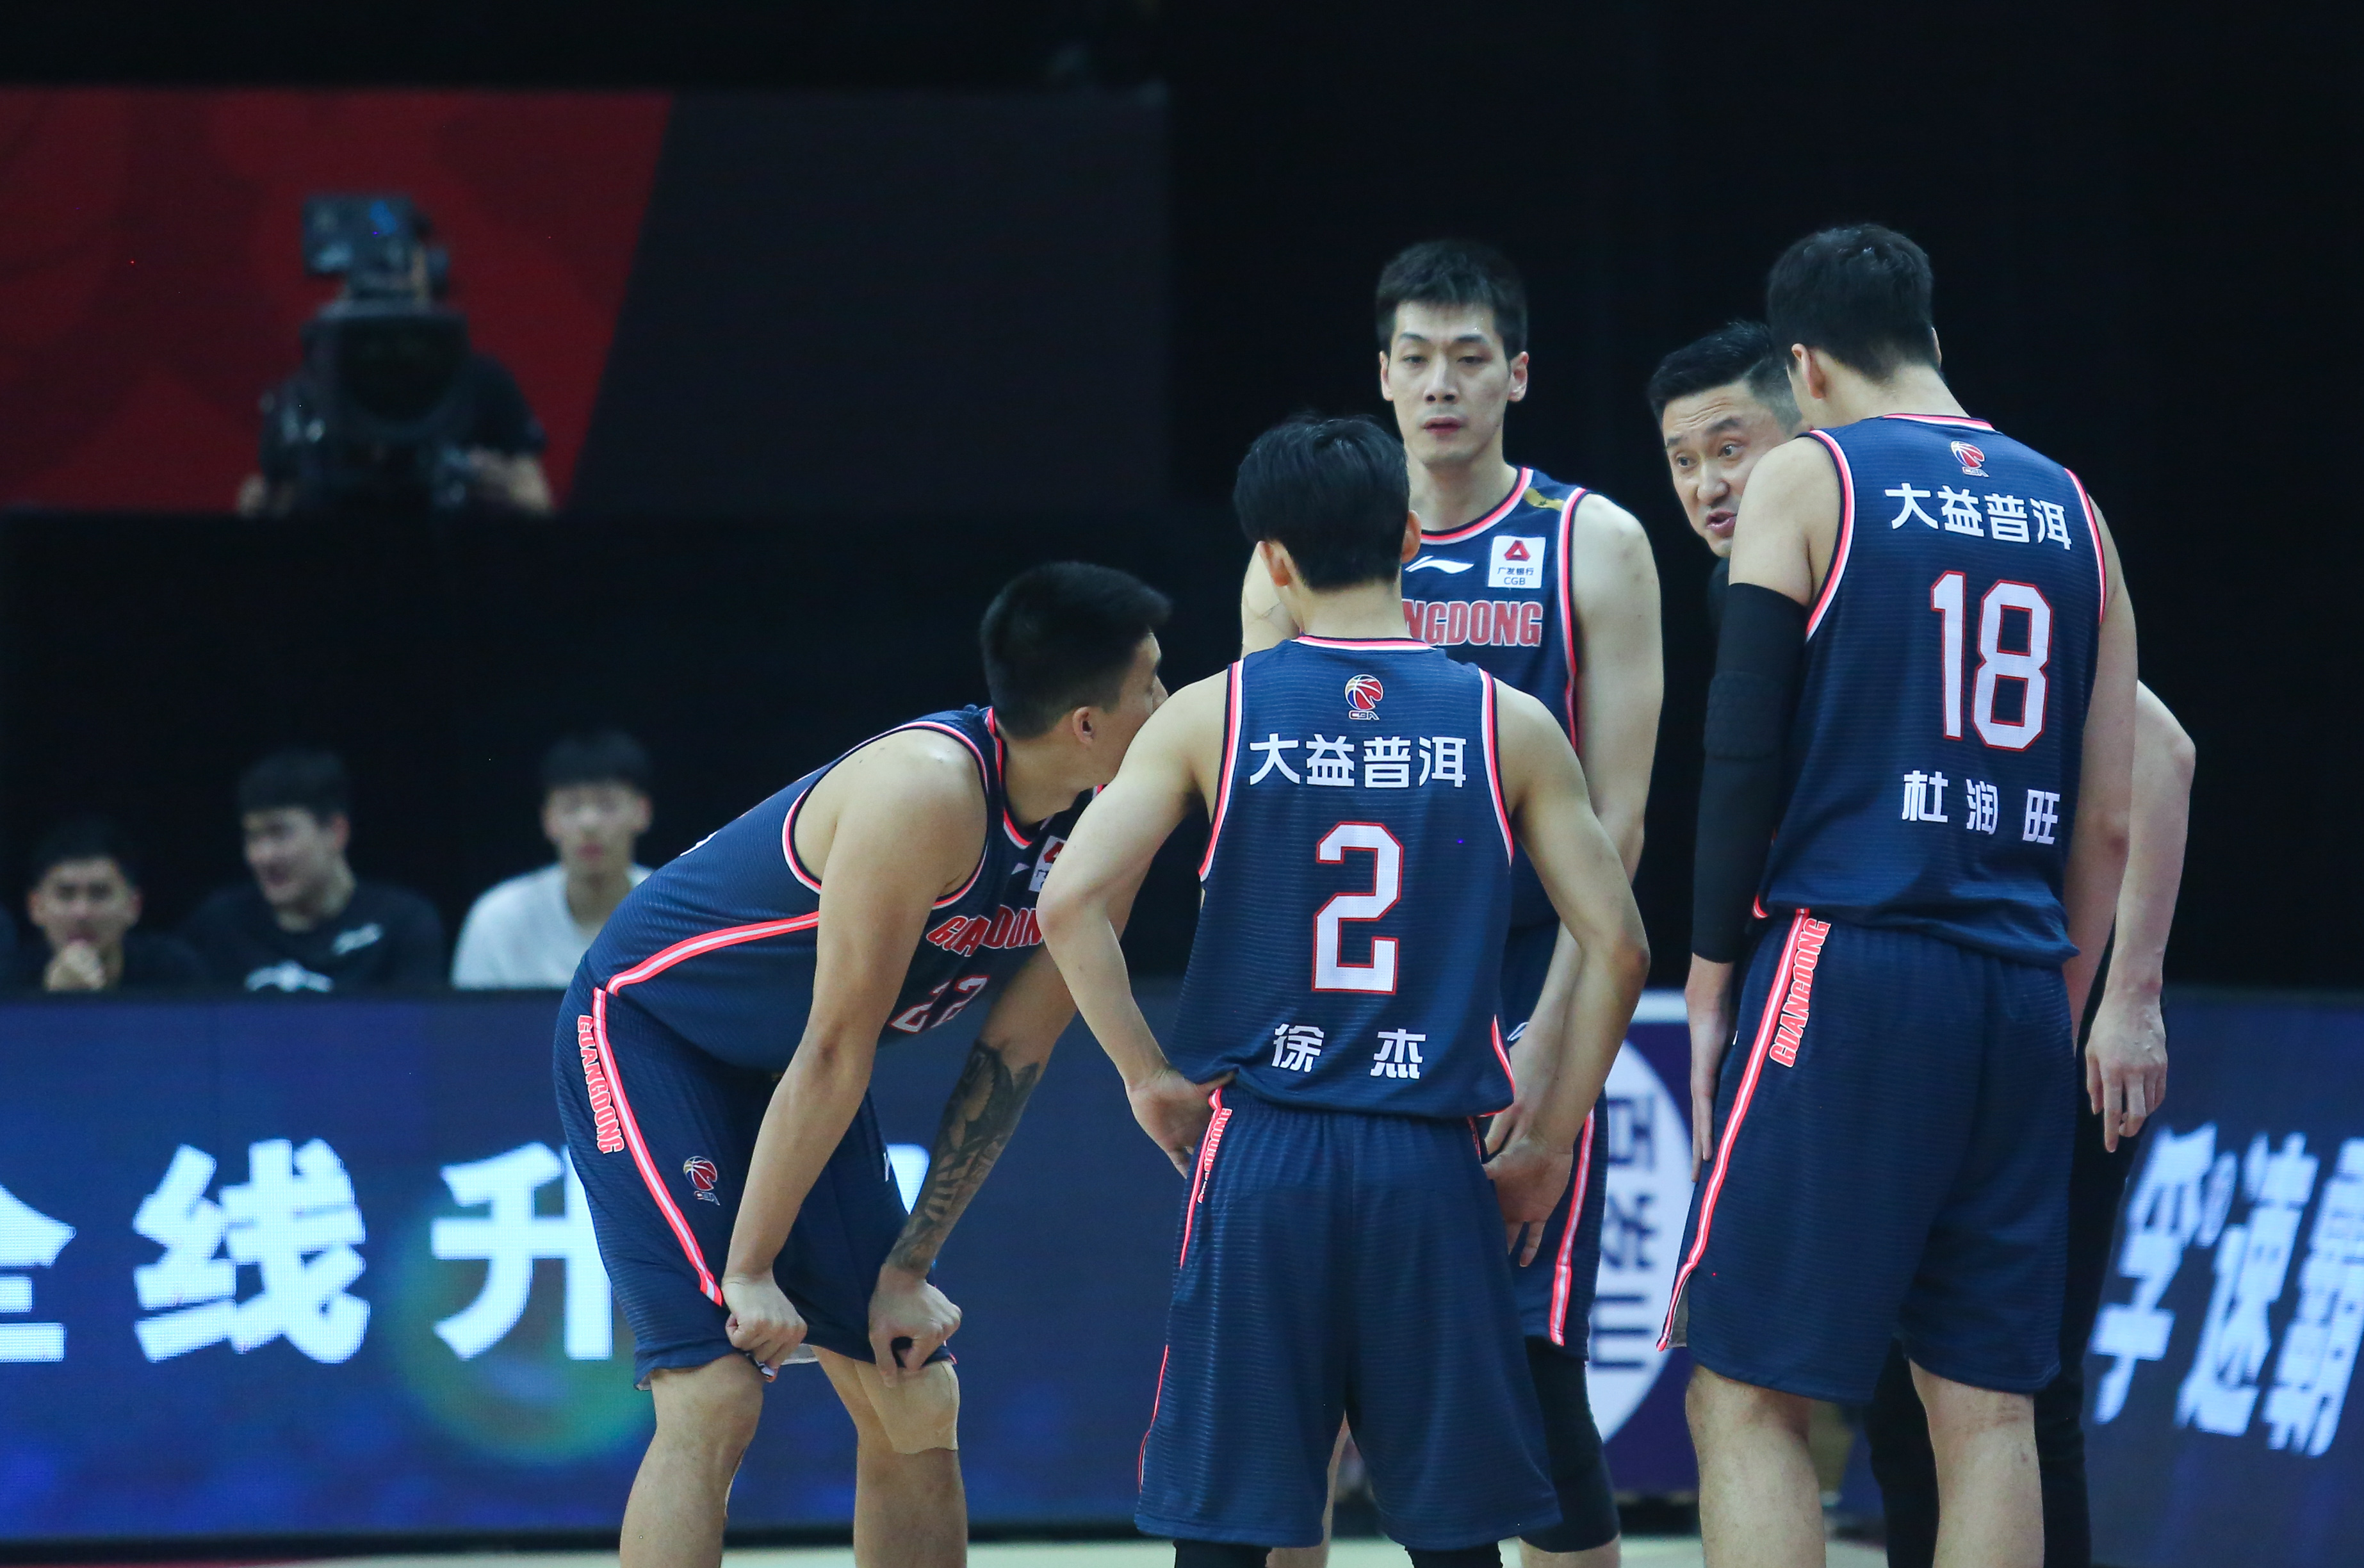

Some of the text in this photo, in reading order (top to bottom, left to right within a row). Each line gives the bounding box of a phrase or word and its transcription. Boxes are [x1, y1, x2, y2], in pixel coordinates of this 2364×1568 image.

[1884, 482, 2072, 551] 大益普洱
[1497, 567, 1535, 576] 广发银行
[1504, 576, 1526, 585] CGB
[1930, 570, 2053, 752] 18
[1348, 710, 1380, 721] CBA
[1249, 733, 1467, 788] 大益普洱
[1901, 769, 2060, 845] 杜润旺
[1311, 821, 1404, 995] 2
[1769, 918, 1831, 1068] GUANGDONG
[577, 1015, 625, 1154] GUANGDONG
[1271, 1023, 1426, 1079] 徐杰
